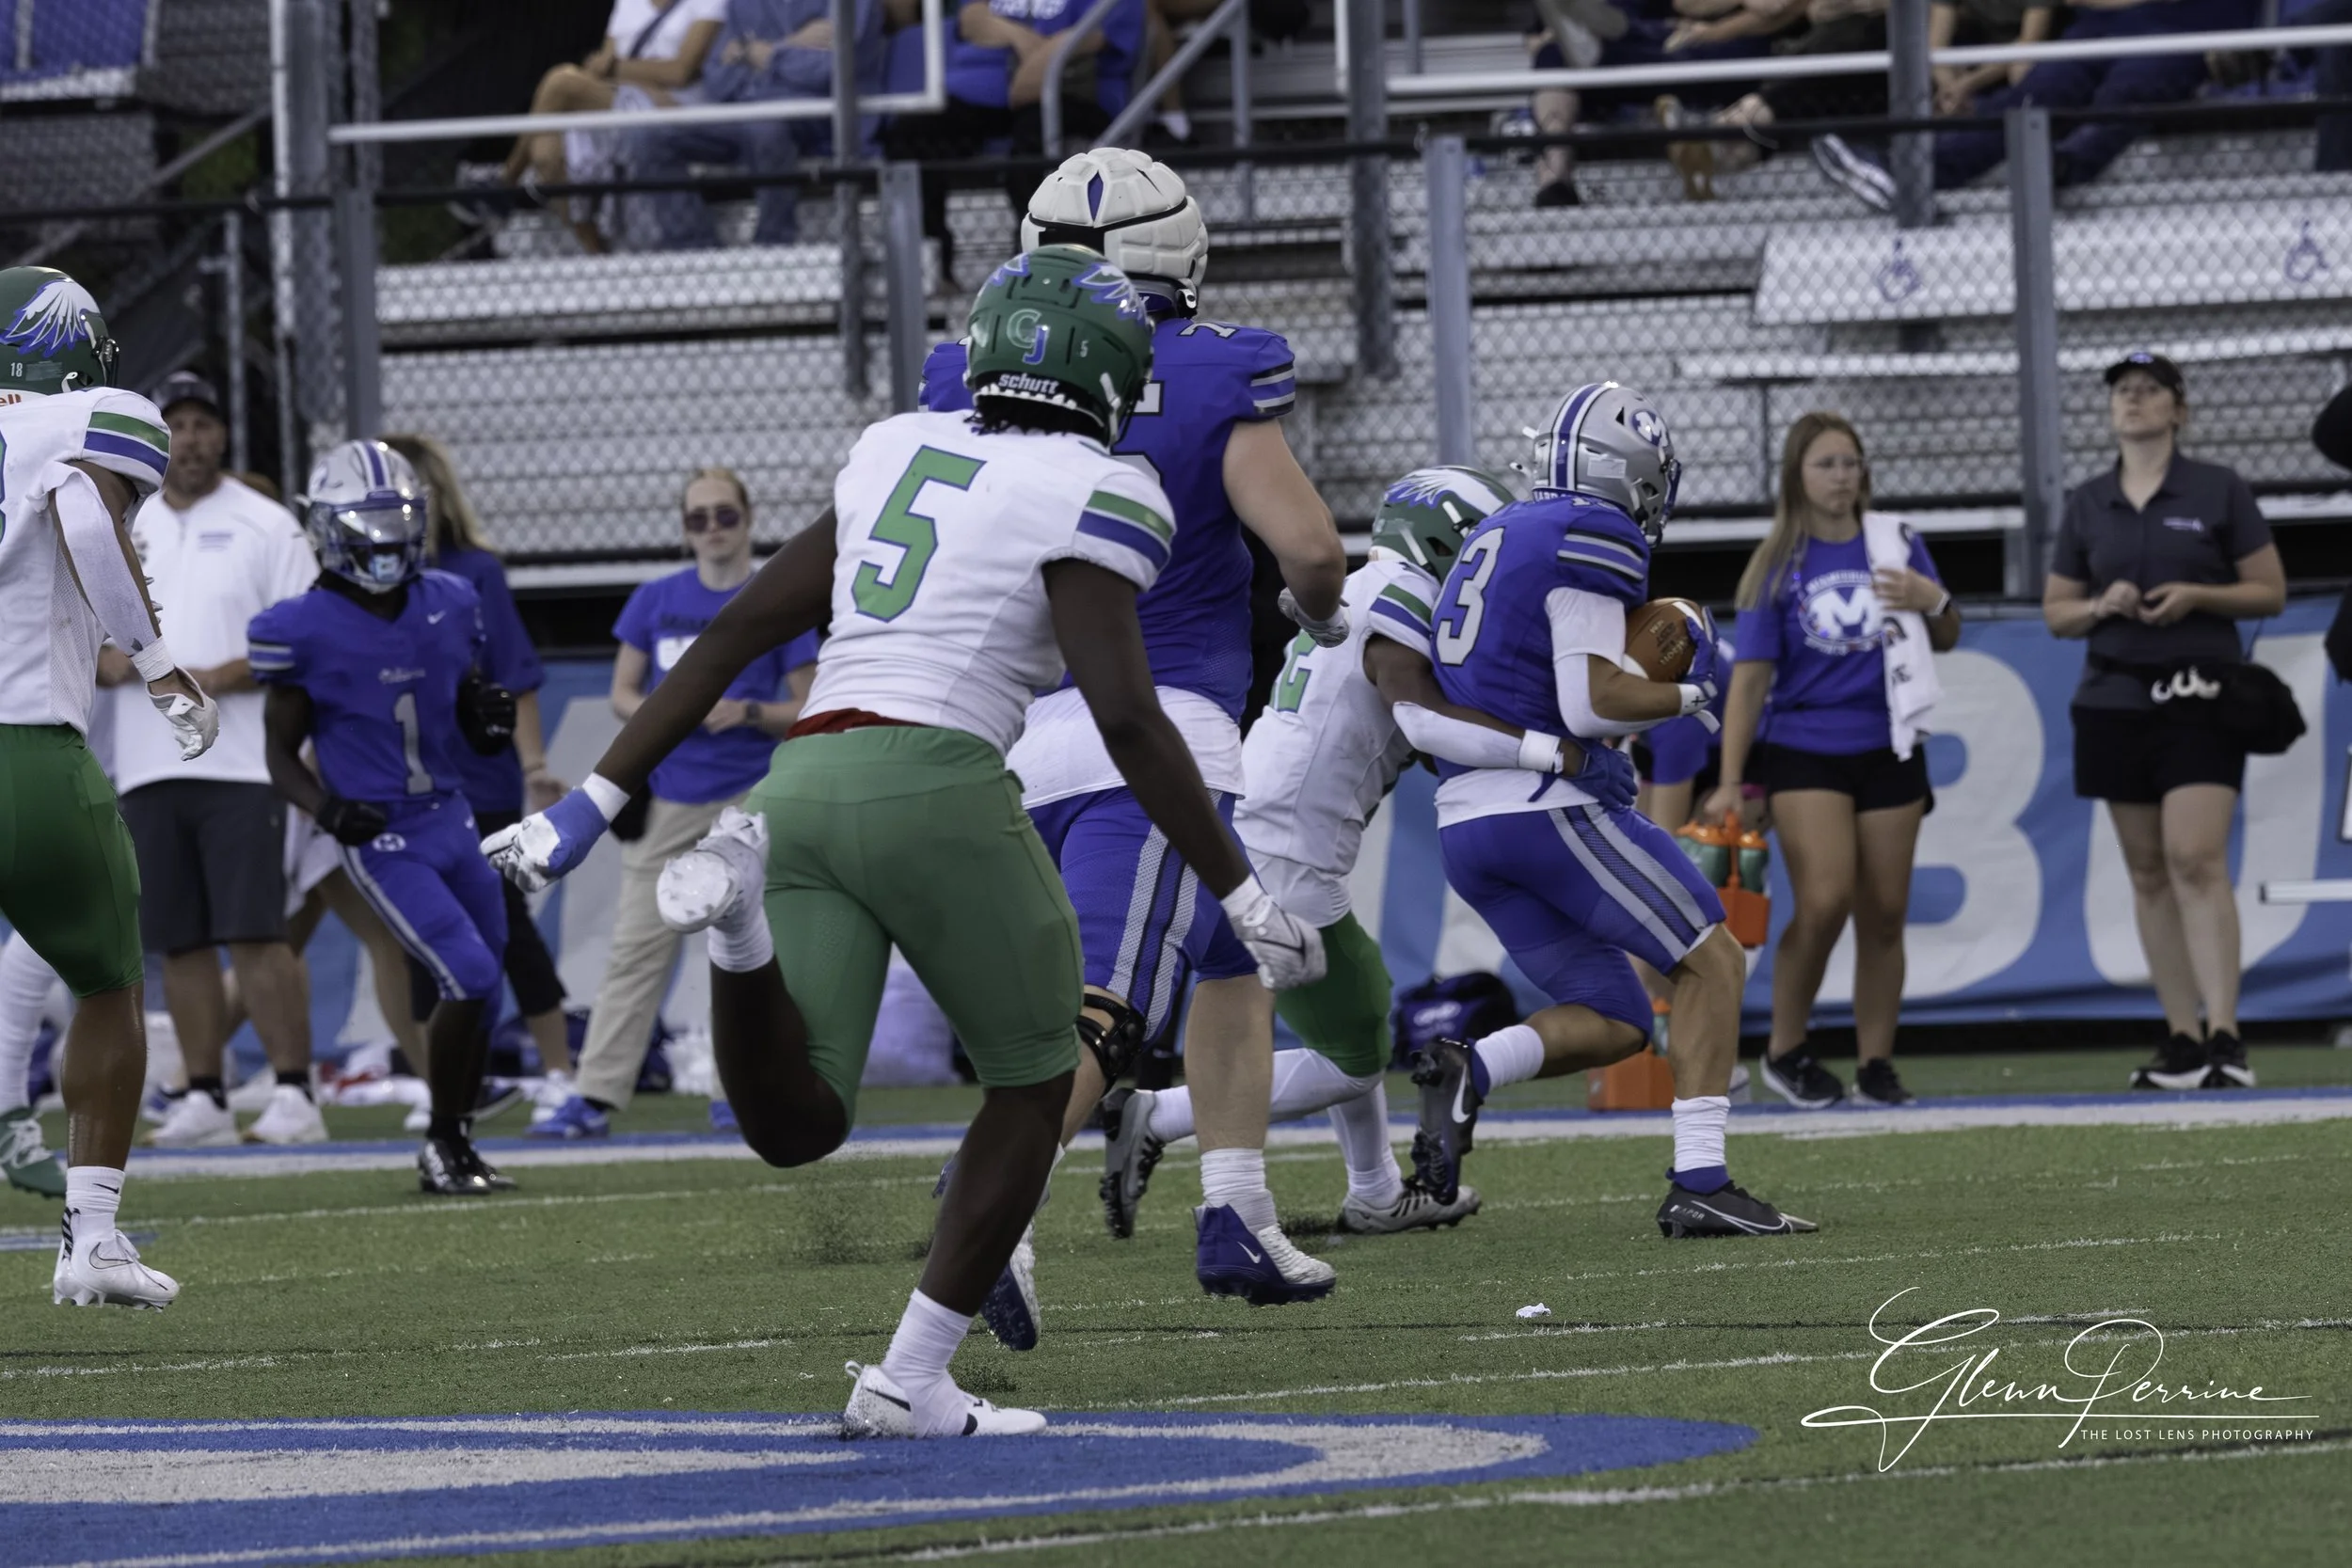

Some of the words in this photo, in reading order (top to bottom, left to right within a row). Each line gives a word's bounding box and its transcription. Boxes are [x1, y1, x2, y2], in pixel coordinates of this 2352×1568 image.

[10, 362, 23, 377] 18
[998, 372, 1061, 395] schutt
[1635, 411, 1668, 447] M
[850, 444, 988, 624] 5
[1434, 527, 1505, 667] 3
[1808, 584, 1882, 639] M
[393, 691, 435, 796] 1
